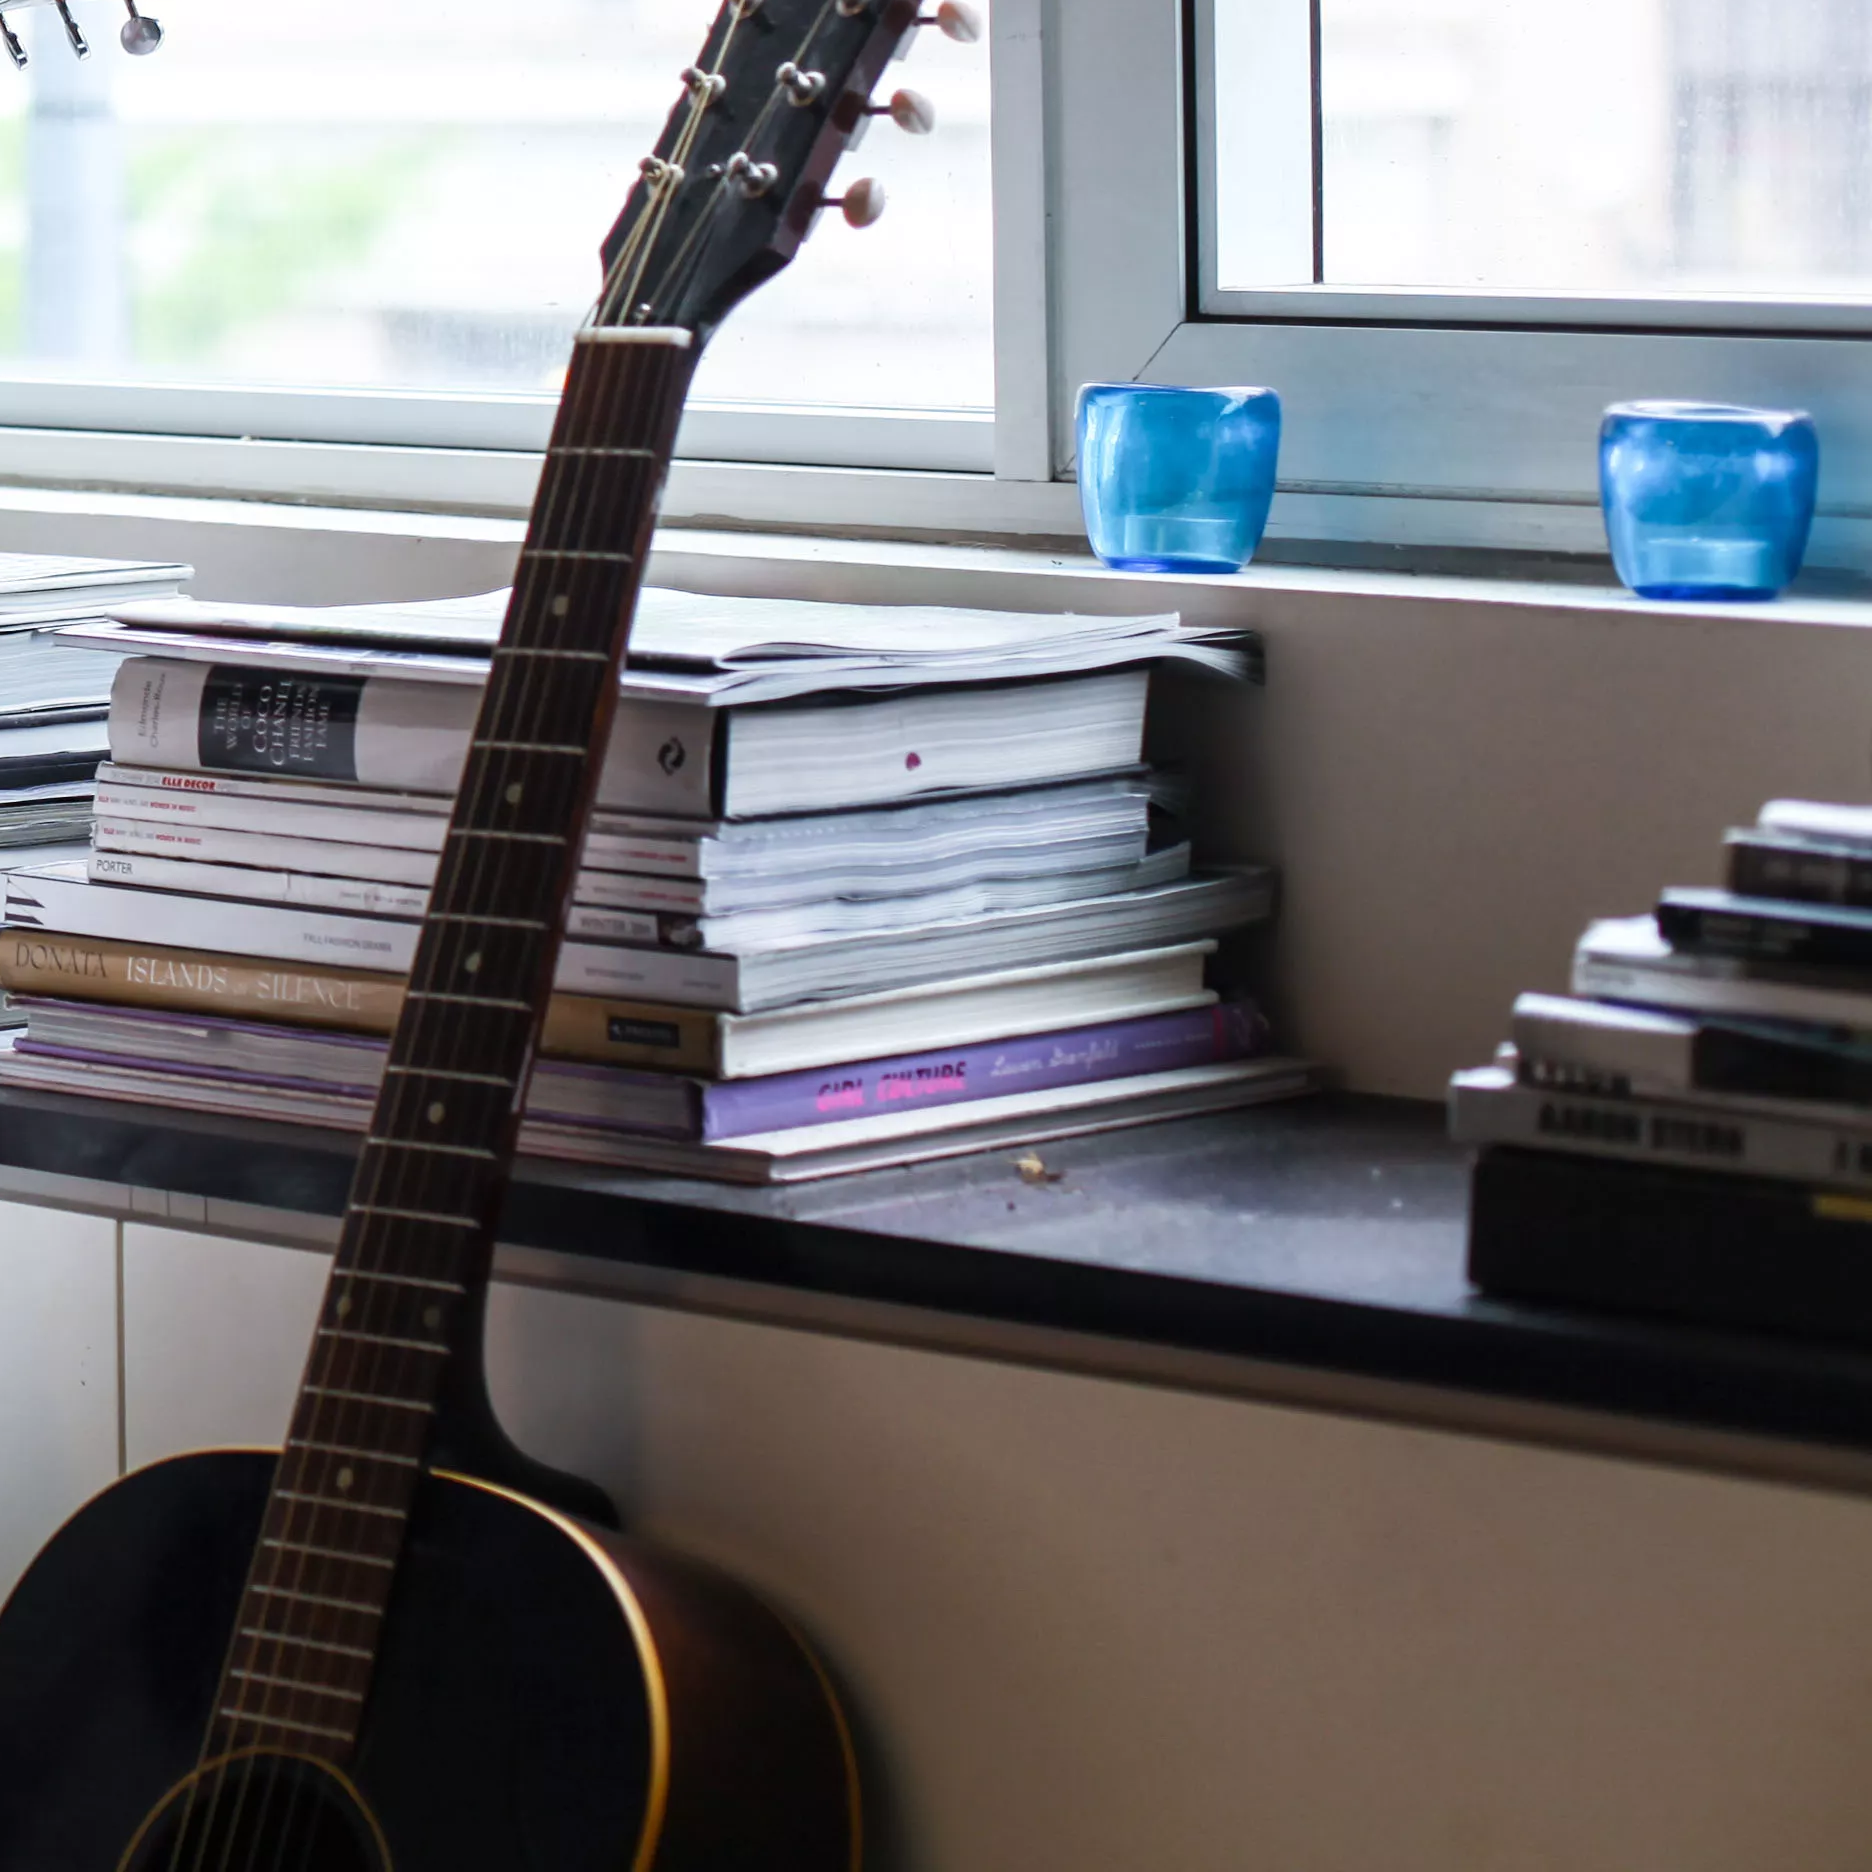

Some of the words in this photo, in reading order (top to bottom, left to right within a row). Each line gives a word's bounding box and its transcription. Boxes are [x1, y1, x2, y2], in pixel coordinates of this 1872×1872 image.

[214, 698, 229, 734] THE
[226, 682, 243, 750] WORLD
[241, 710, 252, 730] OF
[253, 685, 273, 753] COCO
[270, 680, 292, 766] CHANEL
[289, 685, 306, 759] FRIENDS
[303, 685, 320, 762] FASHION
[316, 704, 331, 748] FAME
[161, 775, 183, 788] ELLE
[183, 778, 216, 791] DECOR
[96, 859, 133, 875] PORTER
[15, 942, 109, 978] DONATA
[126, 955, 229, 994] ISLANDS
[257, 972, 361, 1010] SILENCE
